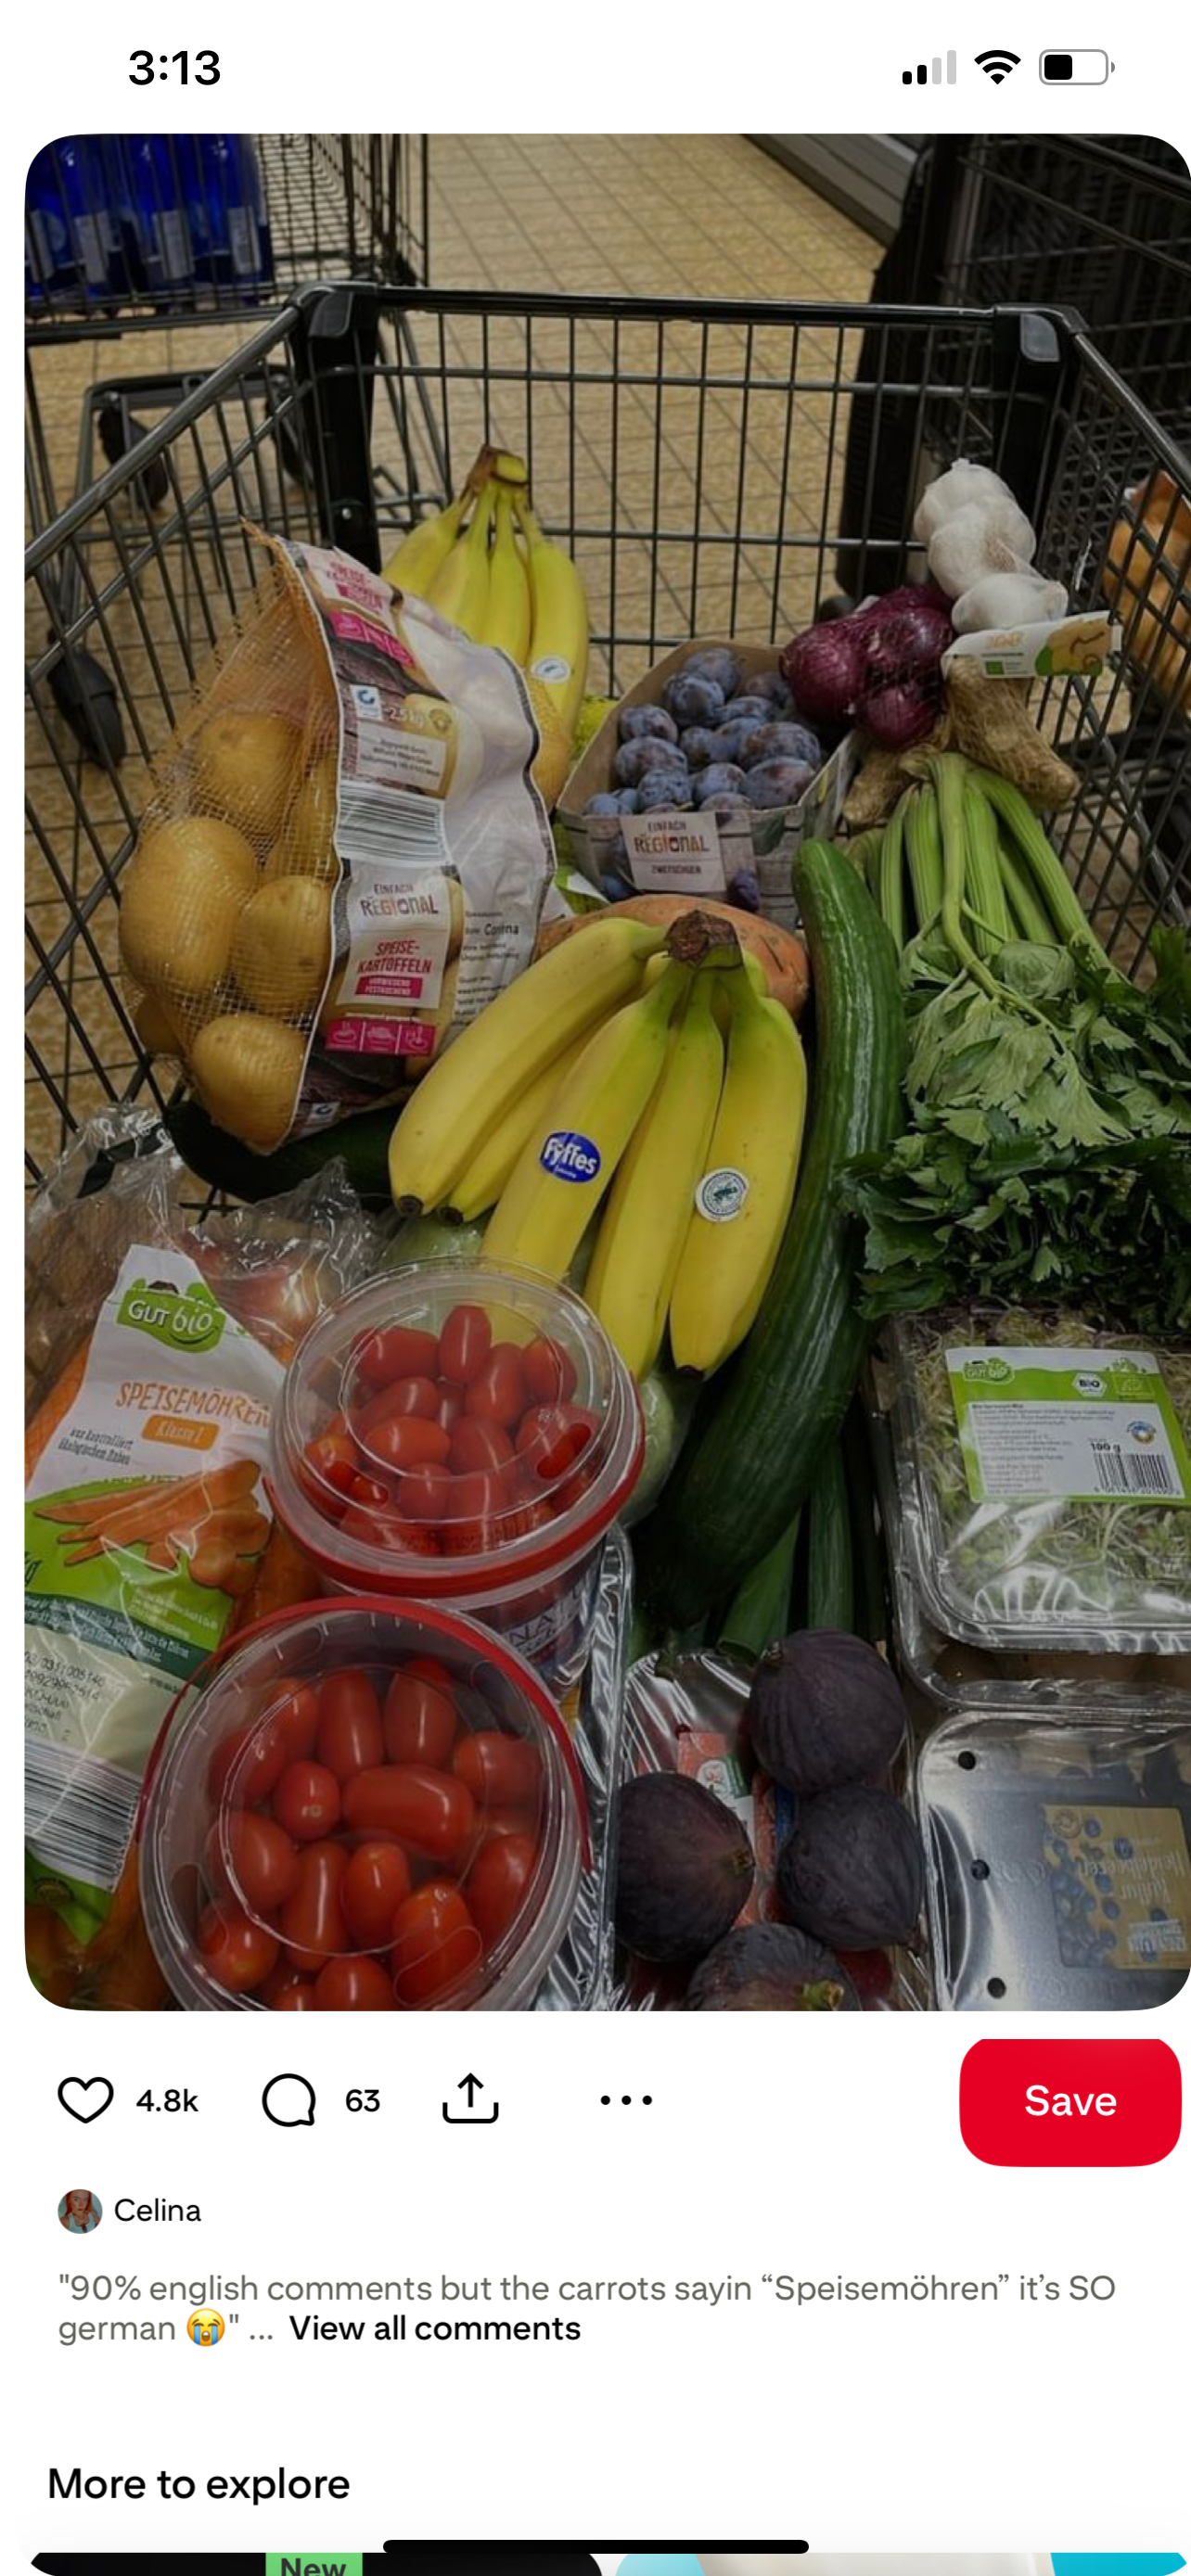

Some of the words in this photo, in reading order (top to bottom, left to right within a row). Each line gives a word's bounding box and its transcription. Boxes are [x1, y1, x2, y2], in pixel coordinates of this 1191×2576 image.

[128, 49, 221, 86] 3:13
[634, 832, 711, 854] REGIONAL
[374, 884, 414, 896] EINFACH
[360, 894, 439, 917] REGIONAL
[375, 939, 420, 956] SPEISE-
[357, 957, 432, 975] KARTOFFELN
[544, 1137, 597, 1176] Fyffes
[128, 1299, 171, 1328] GUT
[172, 1301, 213, 1335] bio
[116, 1382, 271, 1428] SPEISEMÖHREN
[135, 2088, 199, 2112] 4.8k
[345, 2088, 380, 2112] 63
[1024, 2085, 1117, 2117] Save
[114, 2198, 202, 2222] Celina
[59, 2275, 141, 2301] "90%
[150, 2275, 257, 2306] english
[268, 2278, 431, 2301] comments
[442, 2275, 492, 2301] but
[500, 2275, 549, 2301] the
[559, 2278, 665, 2301] carrots
[675, 2276, 750, 2306] sayin
[1069, 2276, 1115, 2301] SO
[59, 2322, 175, 2347] german
[289, 2315, 366, 2341] View
[375, 2315, 406, 2341] all
[415, 2317, 581, 2341] comments
[49, 2468, 146, 2499] More
[157, 2470, 196, 2499] to
[206, 2467, 350, 2506] explore
[281, 2557, 347, 2576] New
